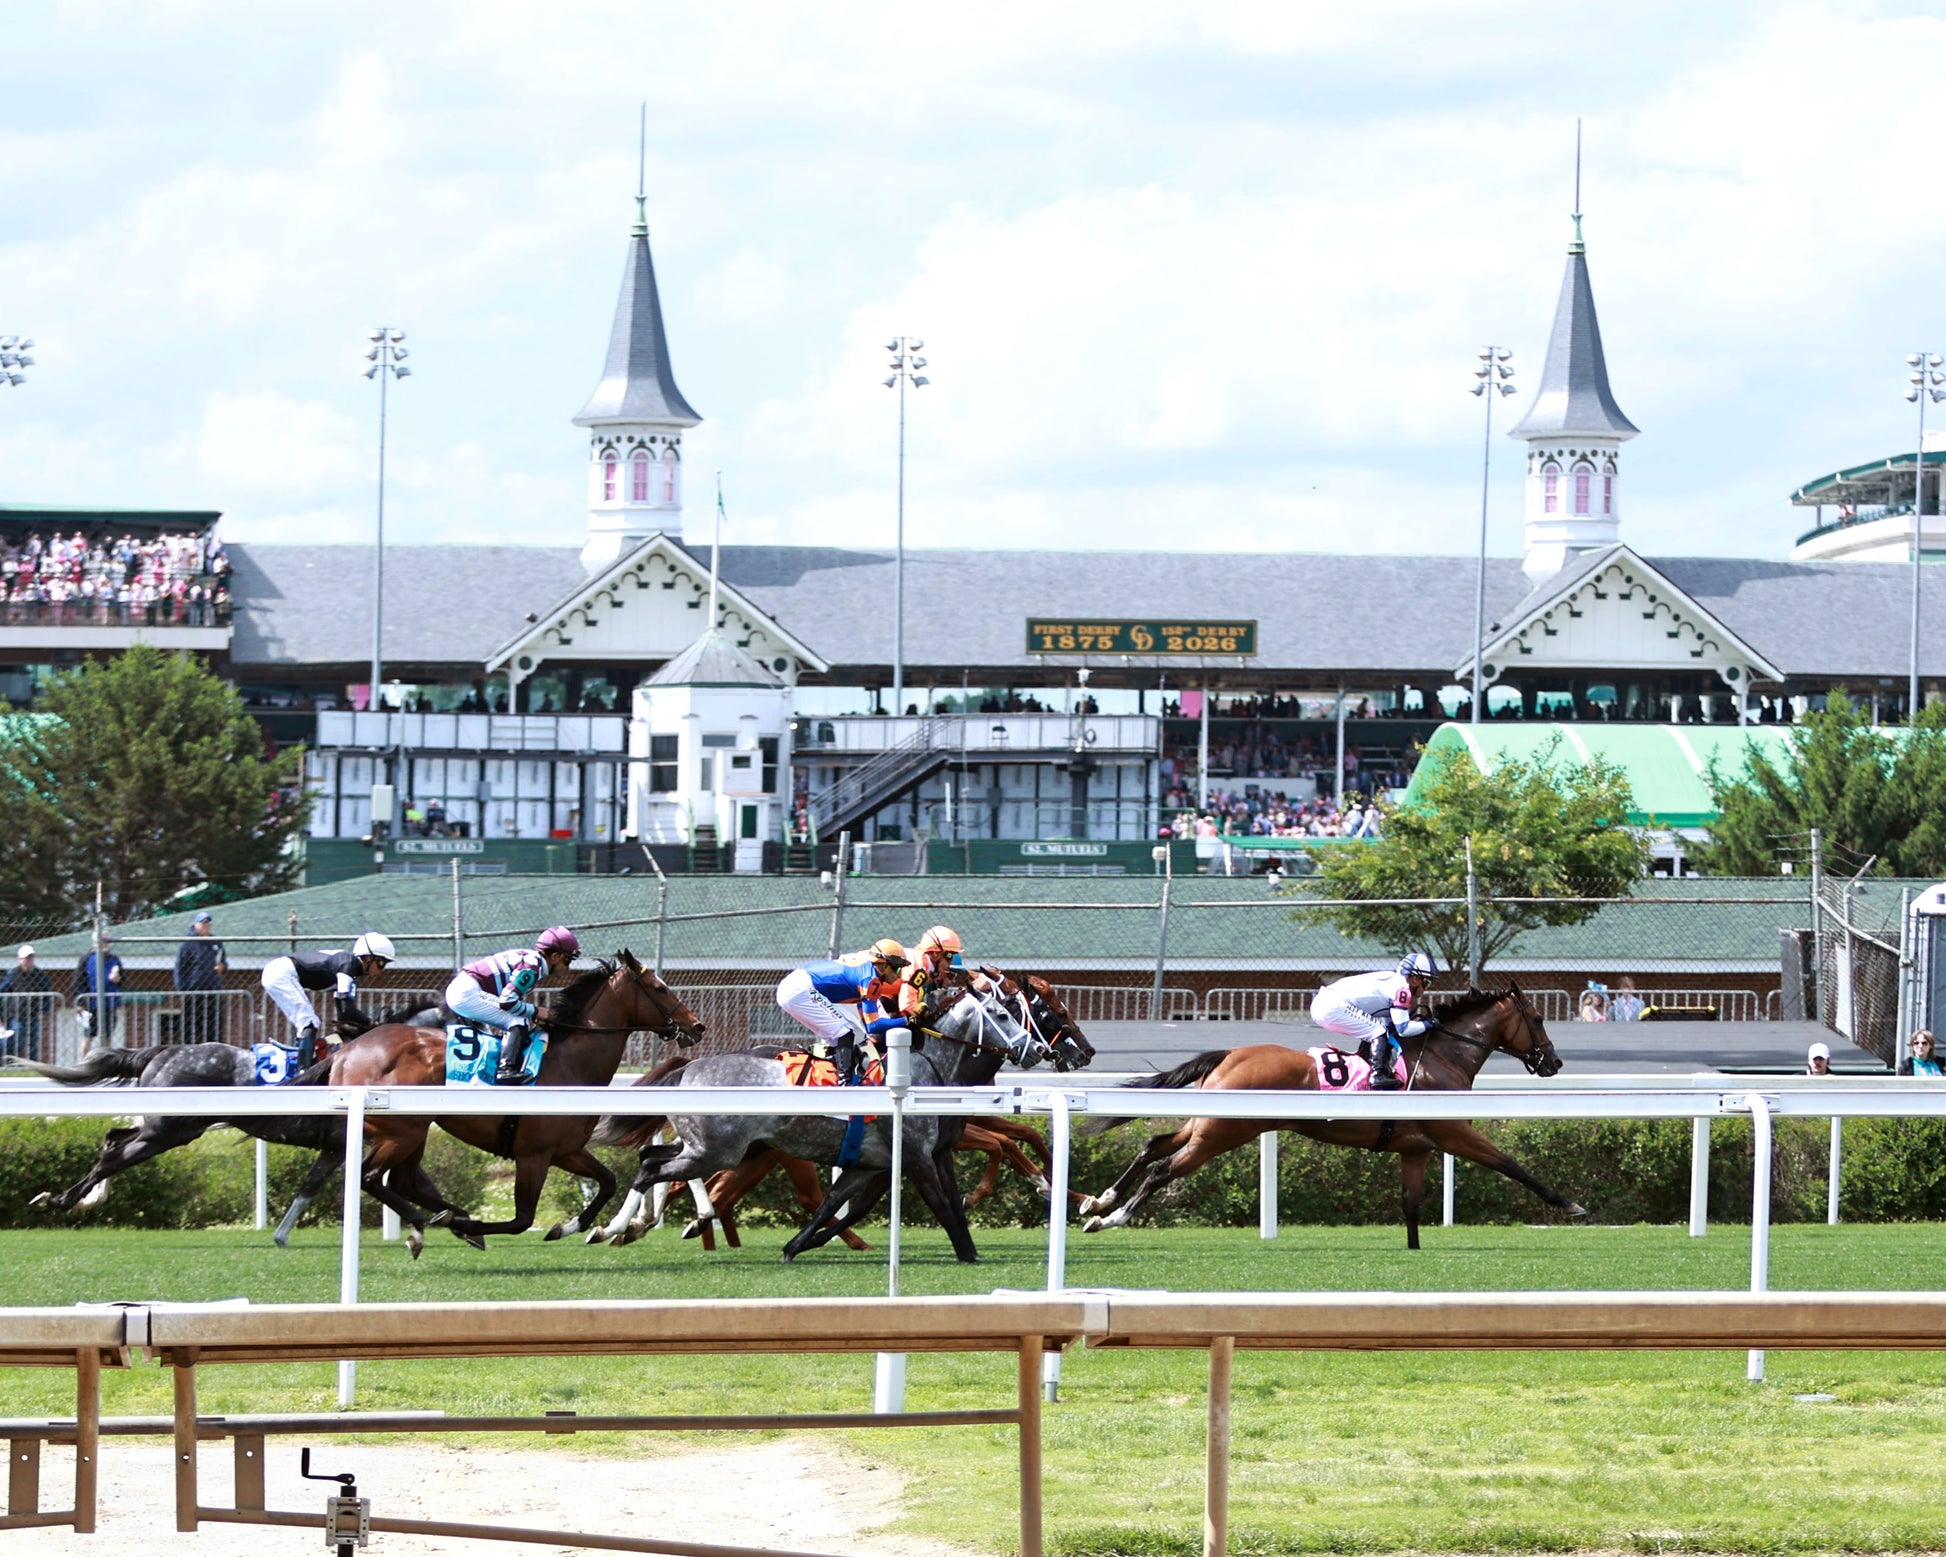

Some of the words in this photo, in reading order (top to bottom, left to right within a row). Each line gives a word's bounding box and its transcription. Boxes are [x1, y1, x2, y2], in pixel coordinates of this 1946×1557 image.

[1034, 625, 1074, 635] FIRST
[1077, 625, 1122, 635] DERBY
[1197, 627, 1247, 636] DERBY
[1042, 635, 1113, 650] 1875
[1167, 637, 1237, 651] 2026
[519, 973, 532, 986] 9
[914, 972, 926, 985] 6
[872, 982, 880, 996] 7
[1399, 991, 1407, 1003] 8
[453, 1026, 480, 1060] 9
[258, 1043, 288, 1083] 3
[1321, 1051, 1349, 1087] 8
